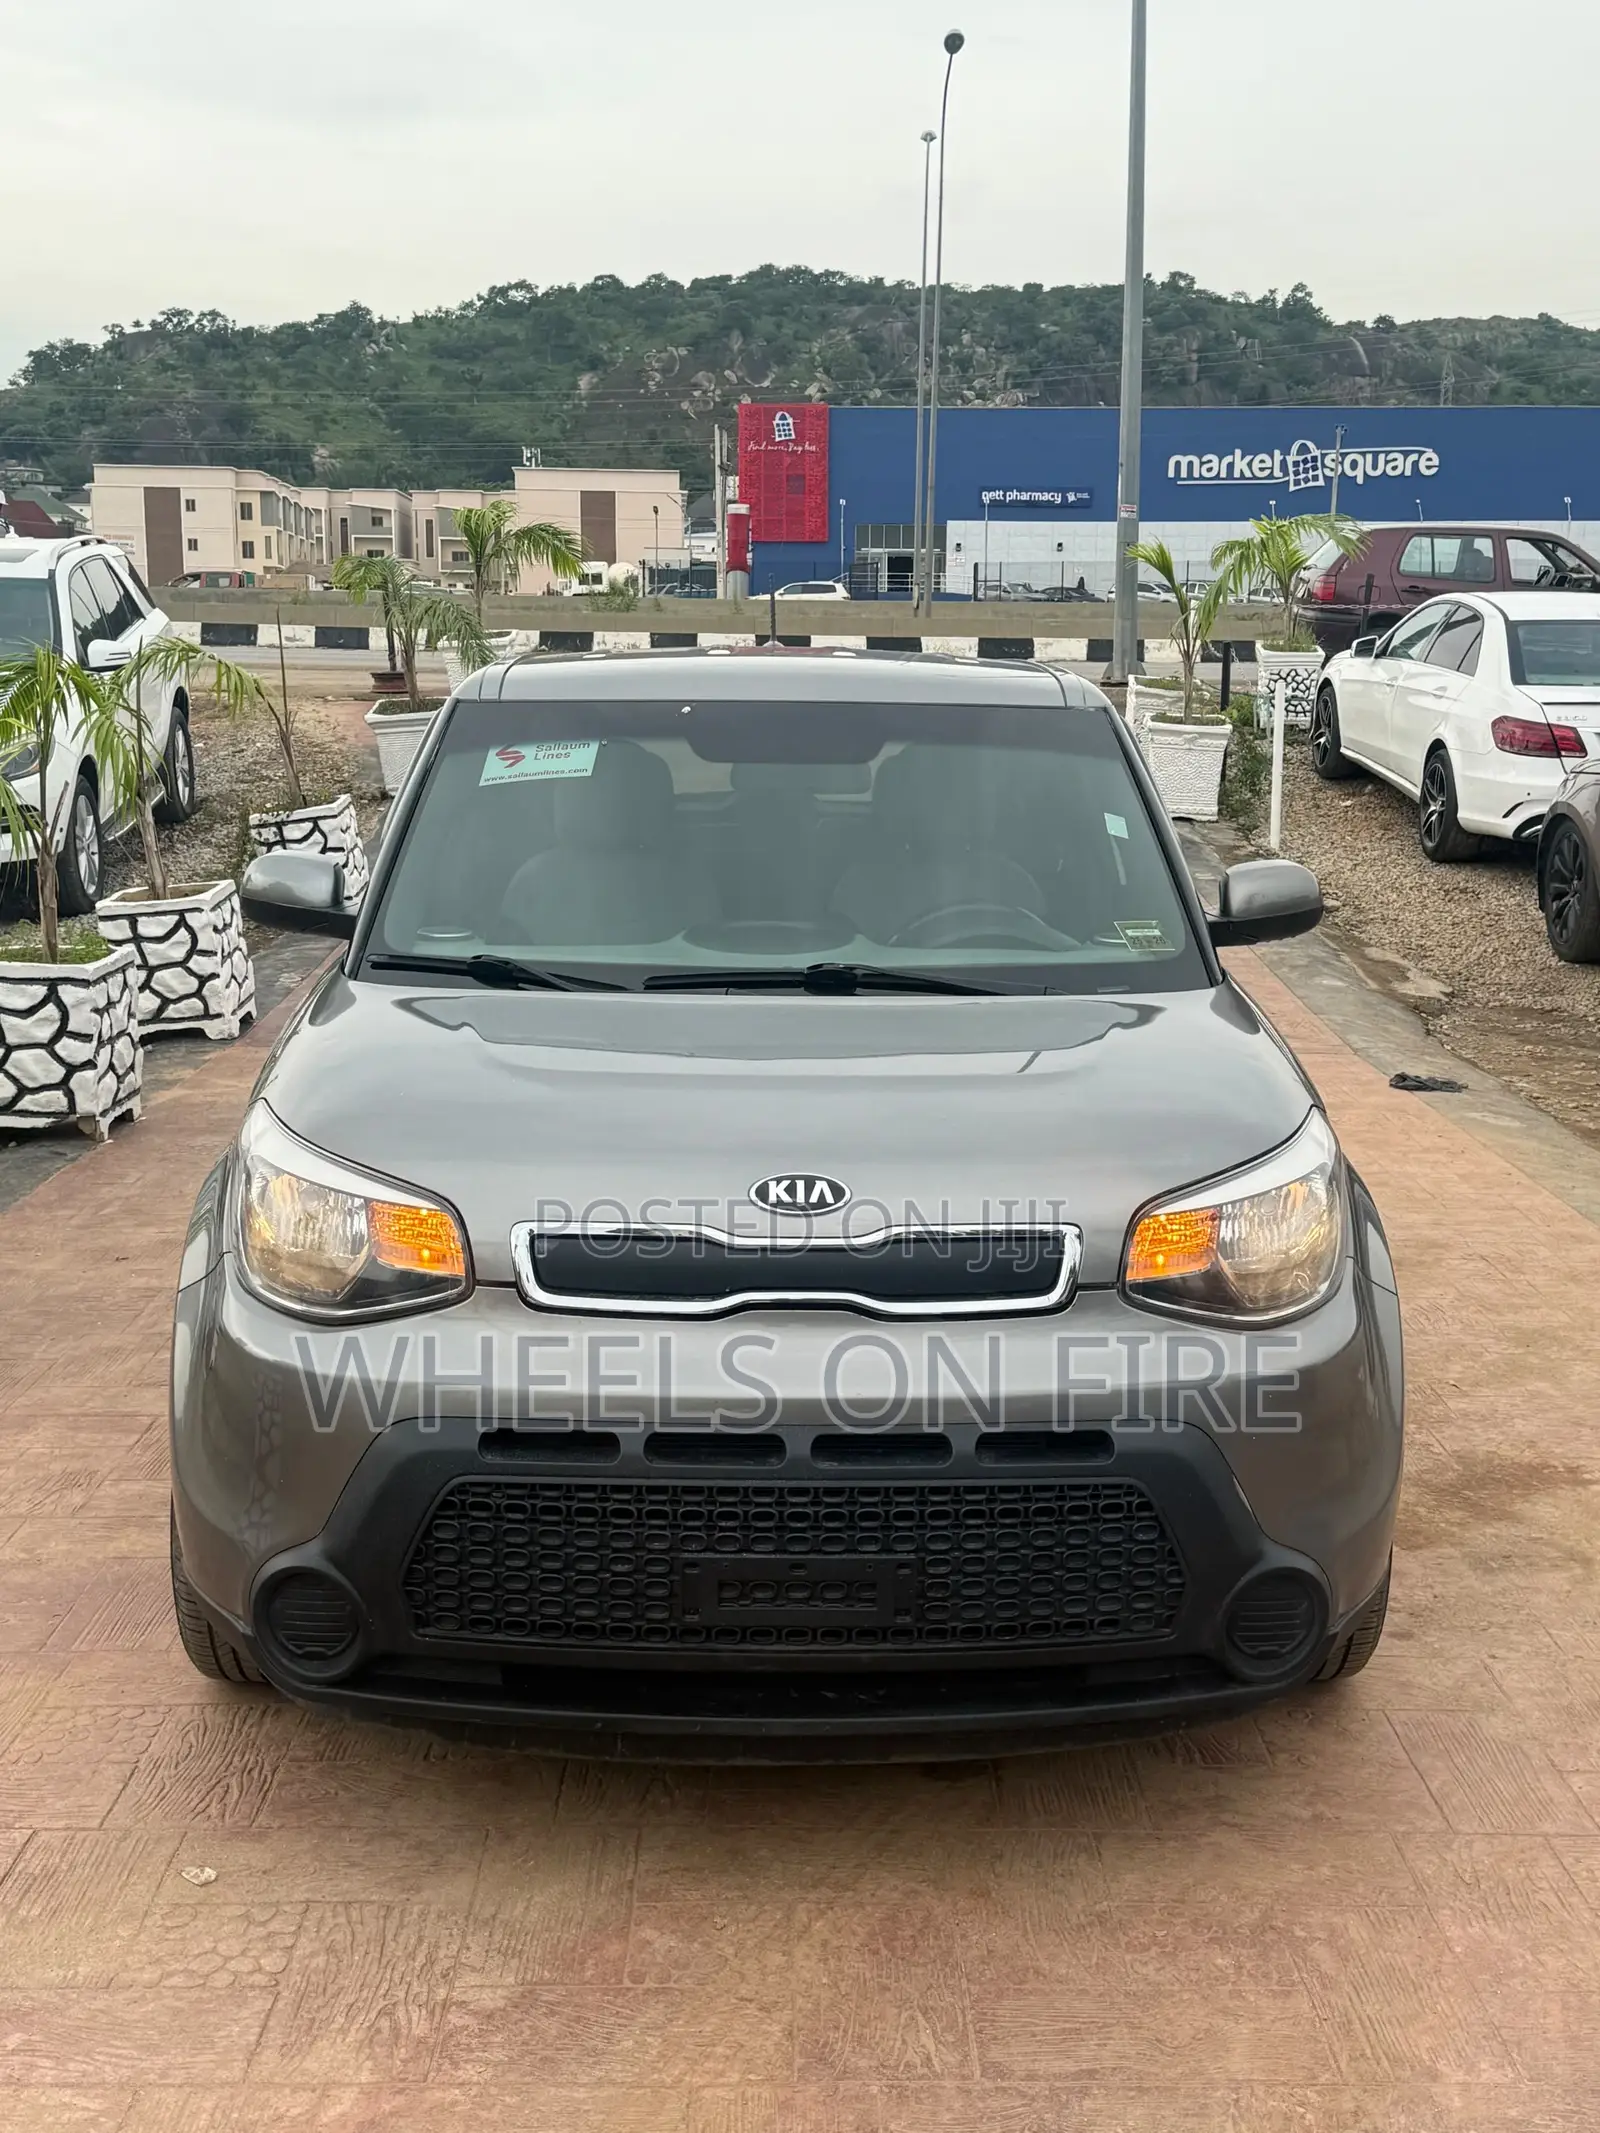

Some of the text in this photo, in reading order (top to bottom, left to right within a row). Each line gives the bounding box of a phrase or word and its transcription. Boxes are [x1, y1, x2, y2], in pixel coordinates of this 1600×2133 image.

[1168, 448, 1440, 485] market square
[1006, 489, 1062, 504] pharmacy
[535, 742, 590, 752] Sallaum
[534, 751, 571, 760] Lines
[484, 768, 588, 782] www.sallaumlines.com
[767, 1180, 835, 1204] KIA
